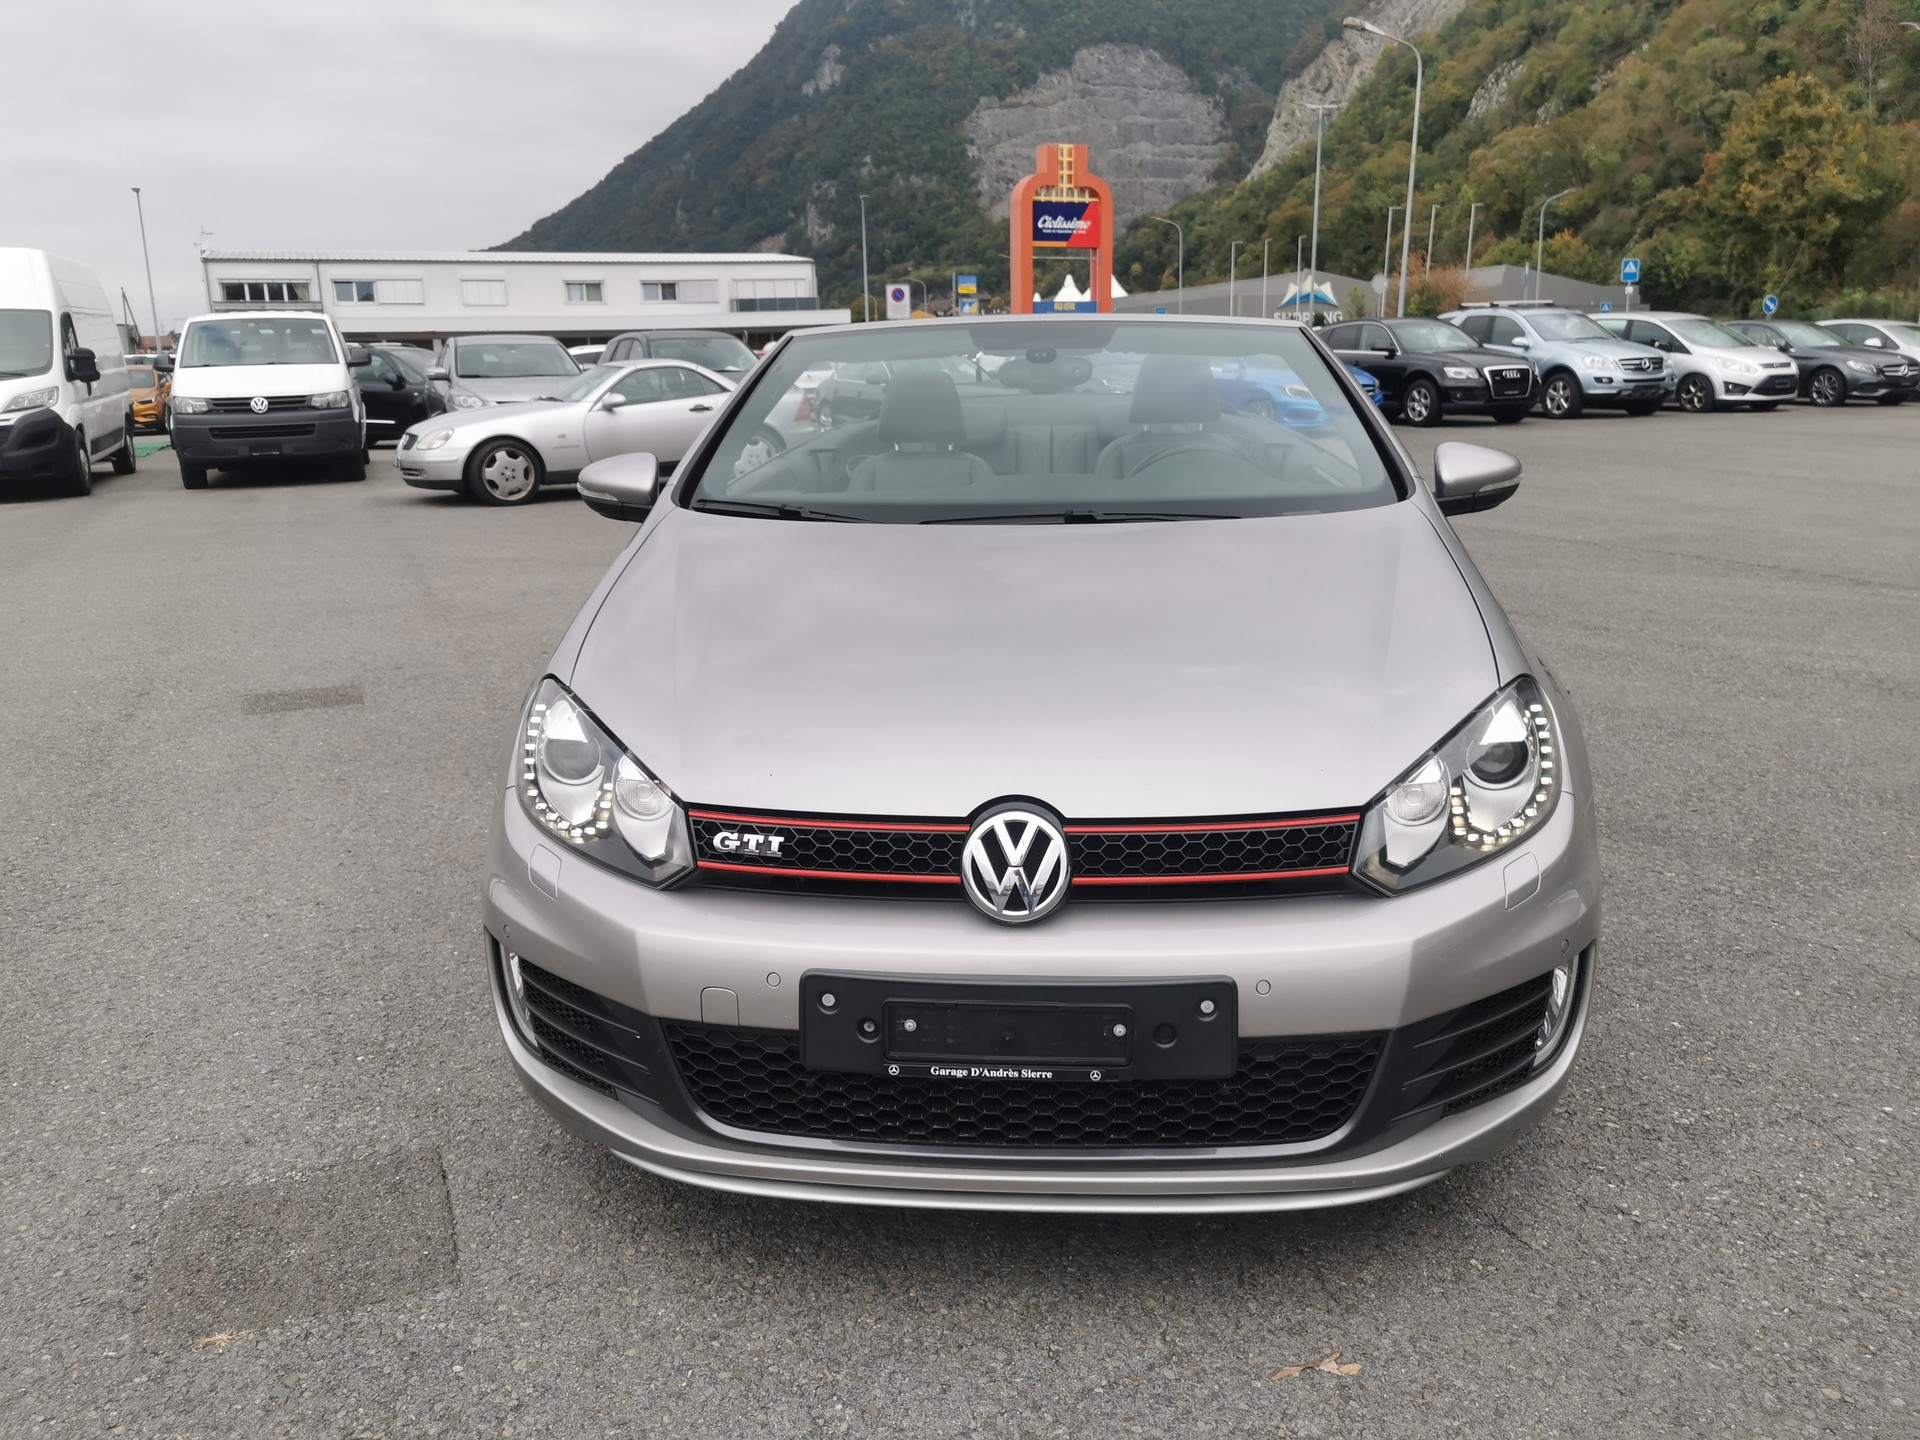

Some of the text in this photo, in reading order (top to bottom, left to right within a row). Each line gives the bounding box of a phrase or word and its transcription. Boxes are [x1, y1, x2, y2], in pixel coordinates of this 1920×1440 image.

[1273, 311, 1343, 324] SHOPNG
[713, 831, 785, 857] GTI
[930, 1066, 1053, 1079] Garage D'Andrès Sierre
